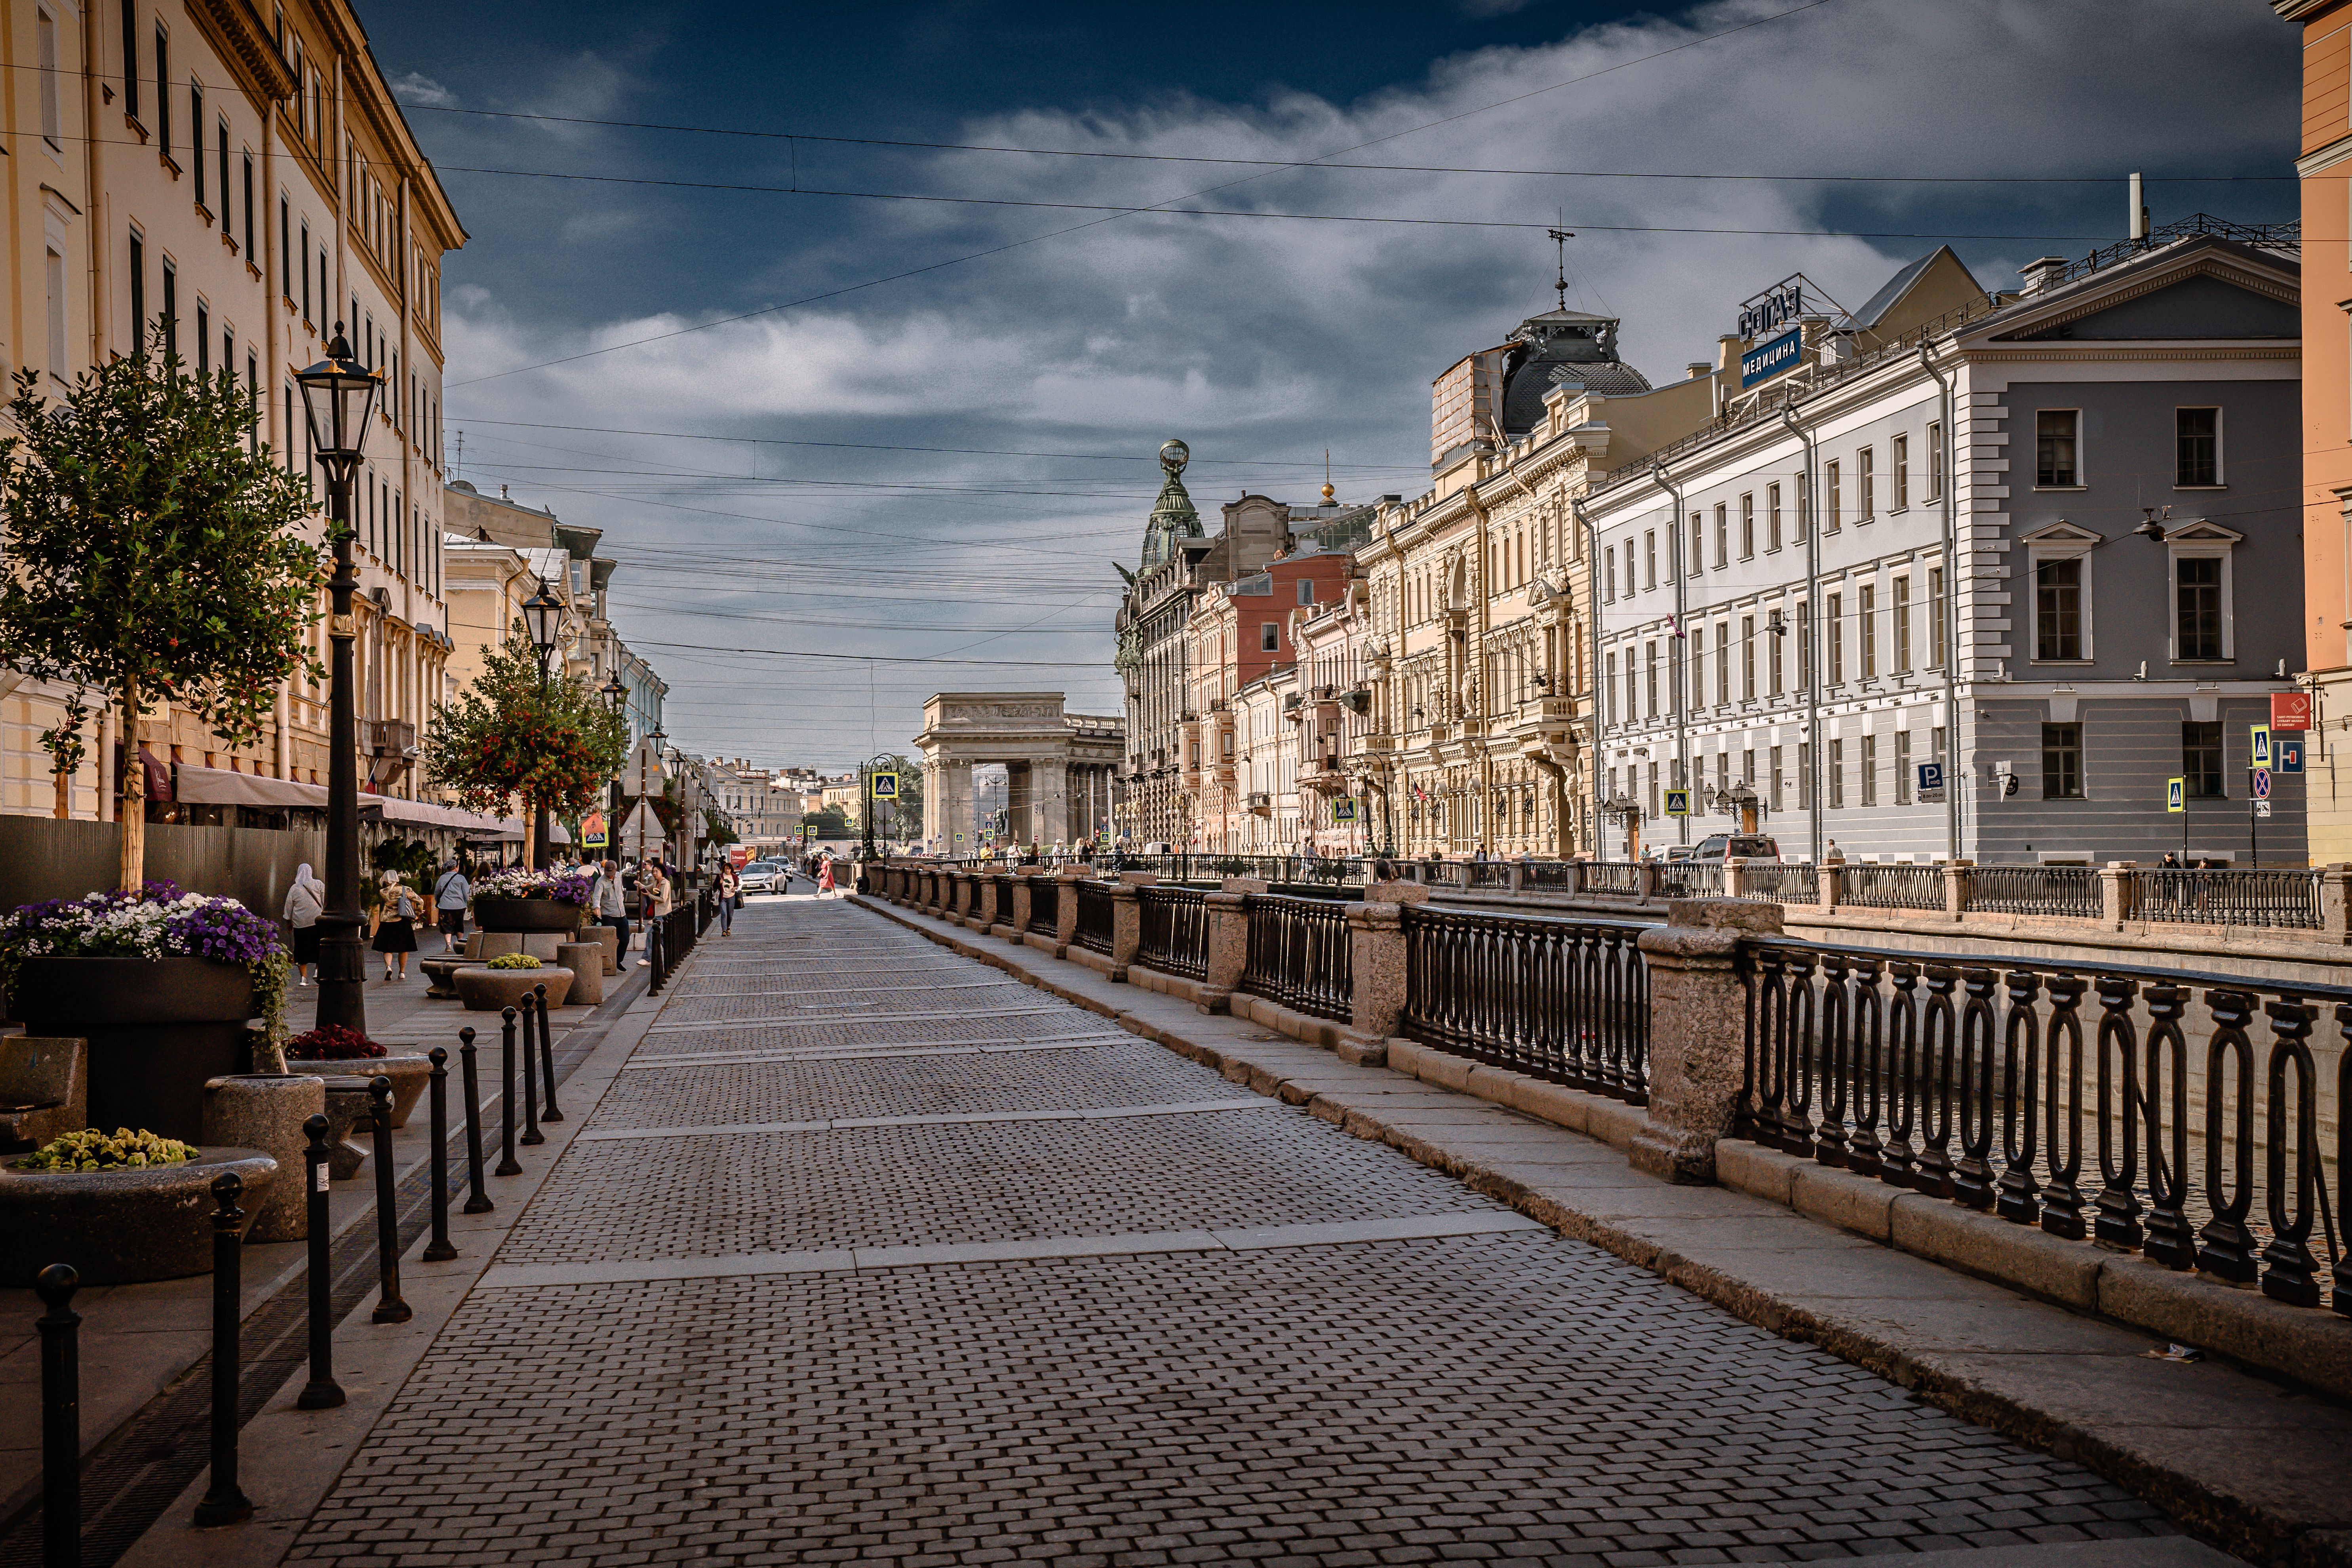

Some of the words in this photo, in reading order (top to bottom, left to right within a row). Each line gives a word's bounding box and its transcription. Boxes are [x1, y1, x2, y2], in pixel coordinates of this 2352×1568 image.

[1738, 286, 1800, 343] СОГАЗ
[1743, 341, 1795, 377] МЕДИЦИНА
[1925, 767, 1937, 786] P
